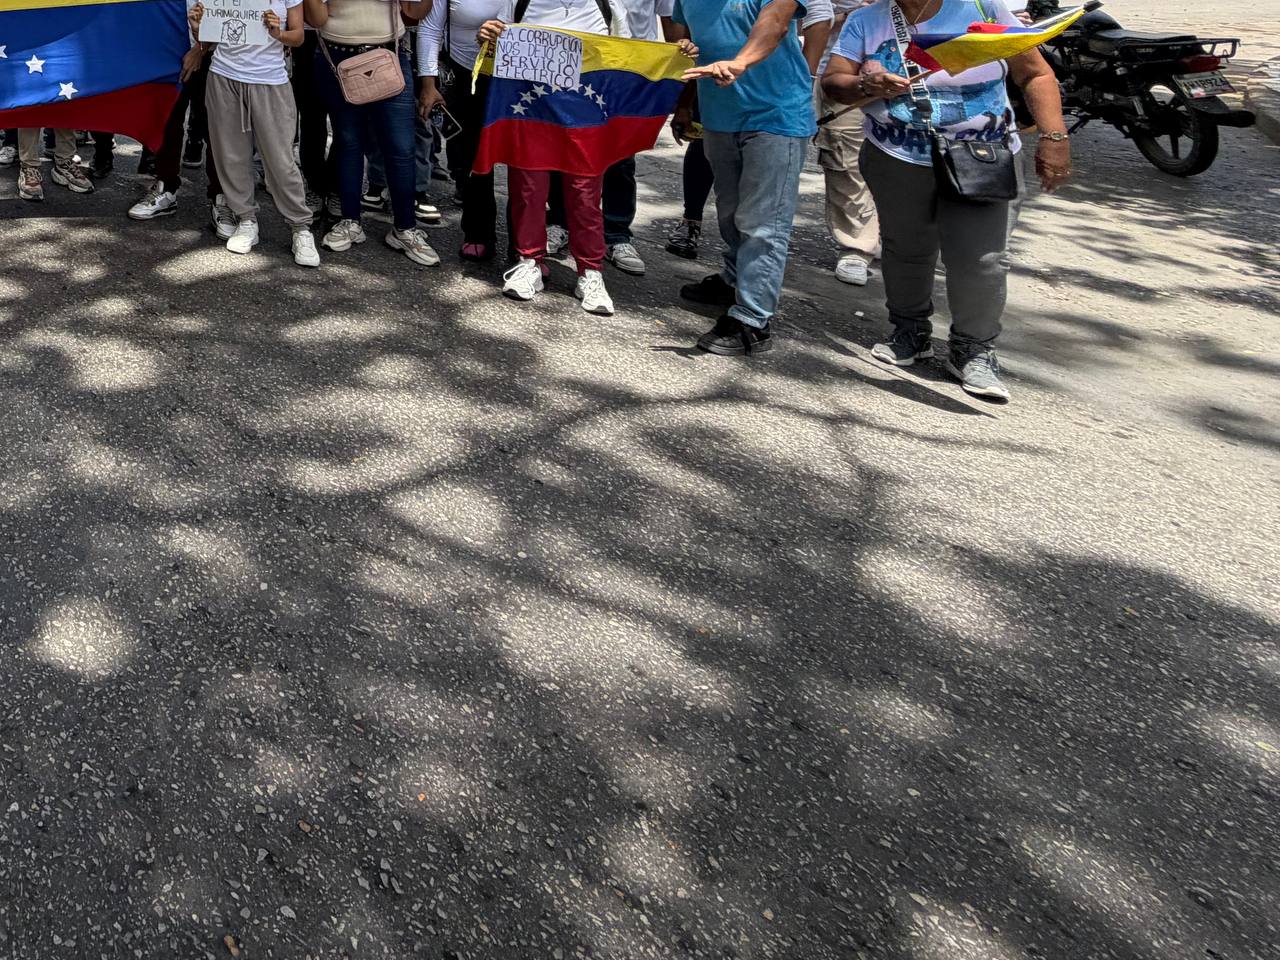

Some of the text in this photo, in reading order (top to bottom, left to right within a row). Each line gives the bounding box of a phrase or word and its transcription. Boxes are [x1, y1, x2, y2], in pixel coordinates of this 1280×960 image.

[499, 28, 514, 40] LA
[497, 41, 520, 57] NOS
[559, 50, 579, 68] SIN
[502, 54, 575, 77] SERVICIO
